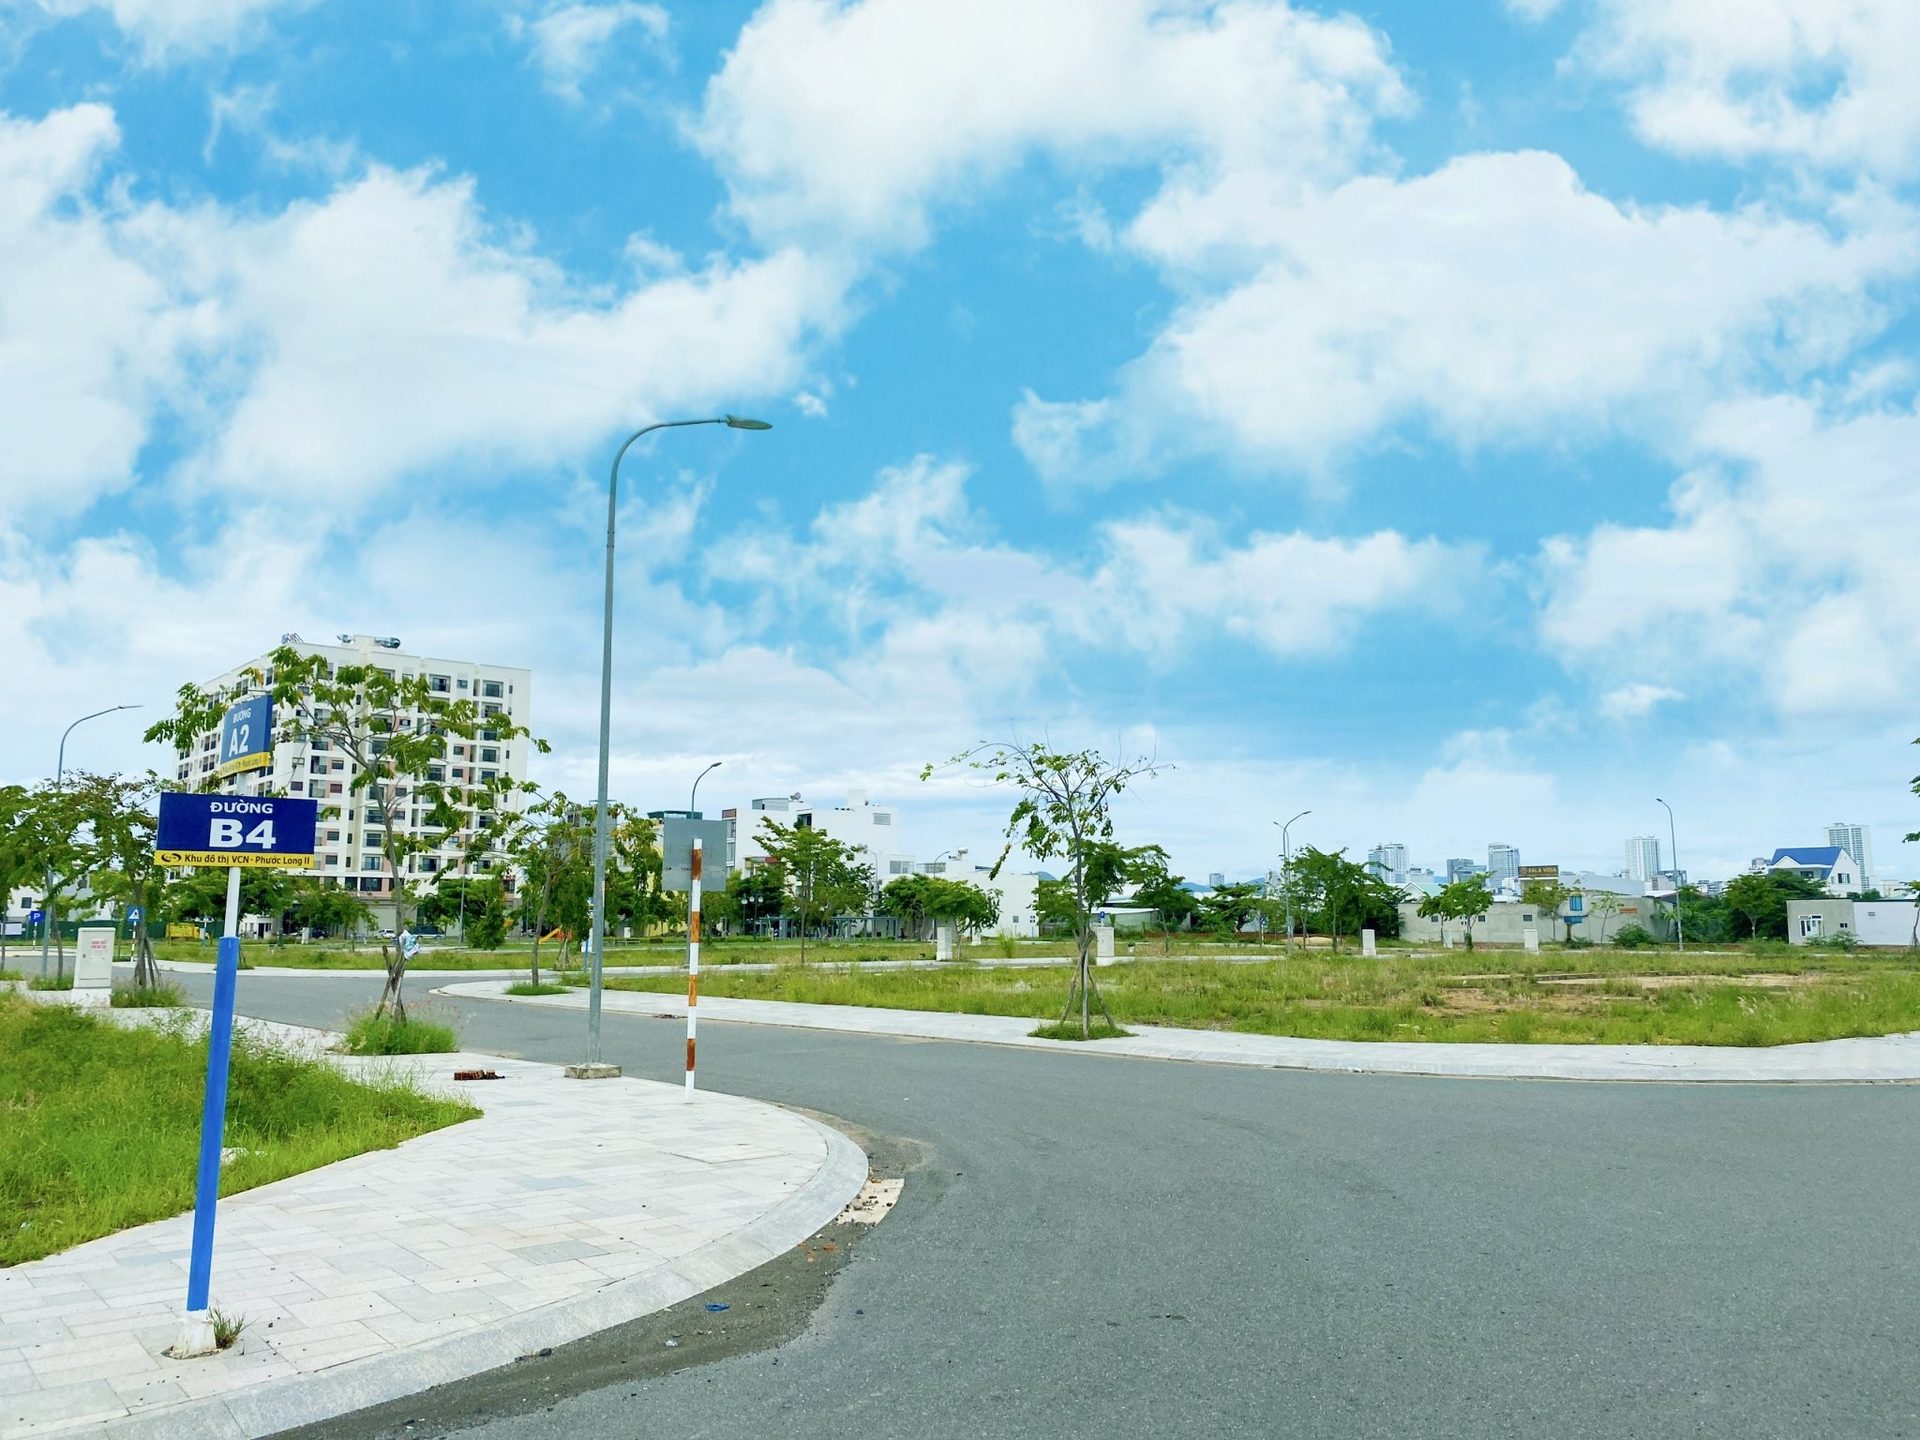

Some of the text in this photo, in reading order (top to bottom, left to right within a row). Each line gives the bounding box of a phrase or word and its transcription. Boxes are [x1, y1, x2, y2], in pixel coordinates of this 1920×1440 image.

[229, 724, 250, 757] A2
[209, 799, 274, 814] ĐƯỜNG
[209, 818, 277, 850] B4
[184, 854, 202, 863] Khu
[217, 855, 230, 865] thị
[255, 855, 282, 865] Phước
[283, 858, 303, 867] Long
[33, 912, 41, 920] P
